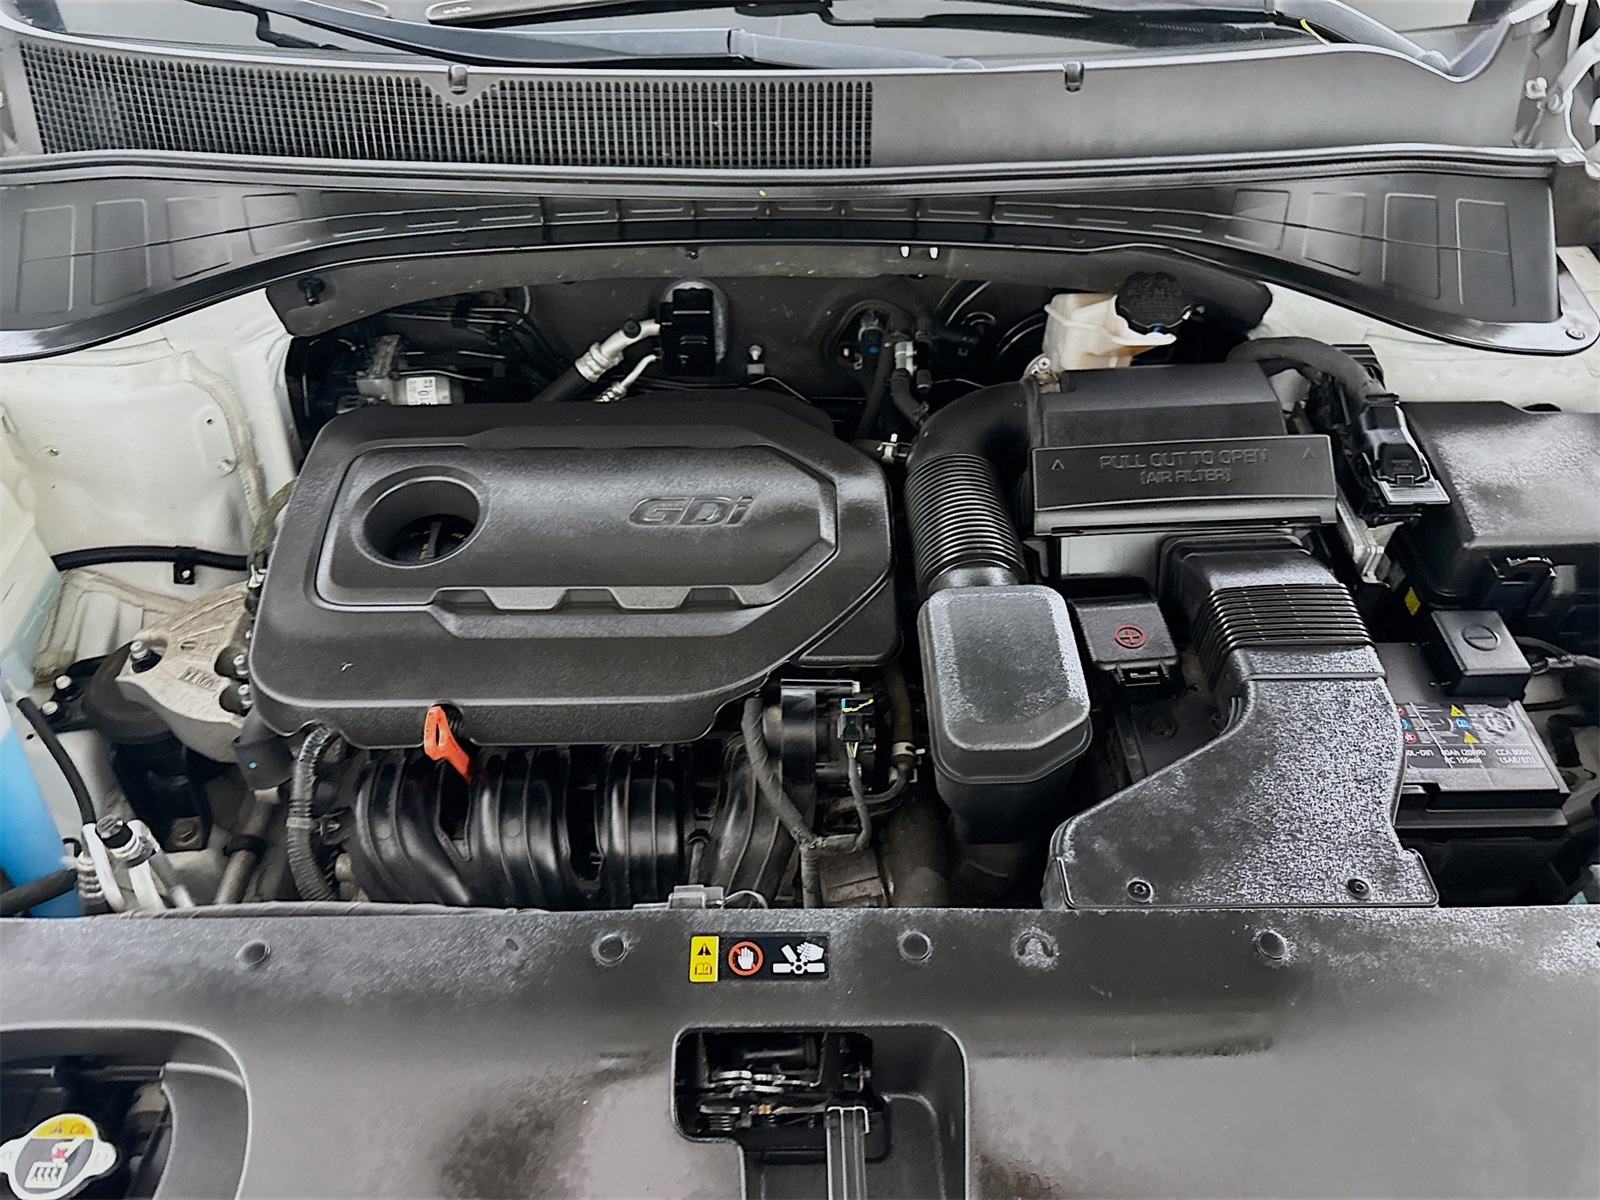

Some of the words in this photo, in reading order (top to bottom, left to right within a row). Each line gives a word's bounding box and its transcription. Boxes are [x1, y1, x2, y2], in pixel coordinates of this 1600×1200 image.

[1098, 453, 1146, 469] PULL
[1150, 451, 1188, 467] OUT
[1190, 450, 1214, 466] TO
[1219, 448, 1268, 465] OPEN
[629, 496, 754, 526] GDi
